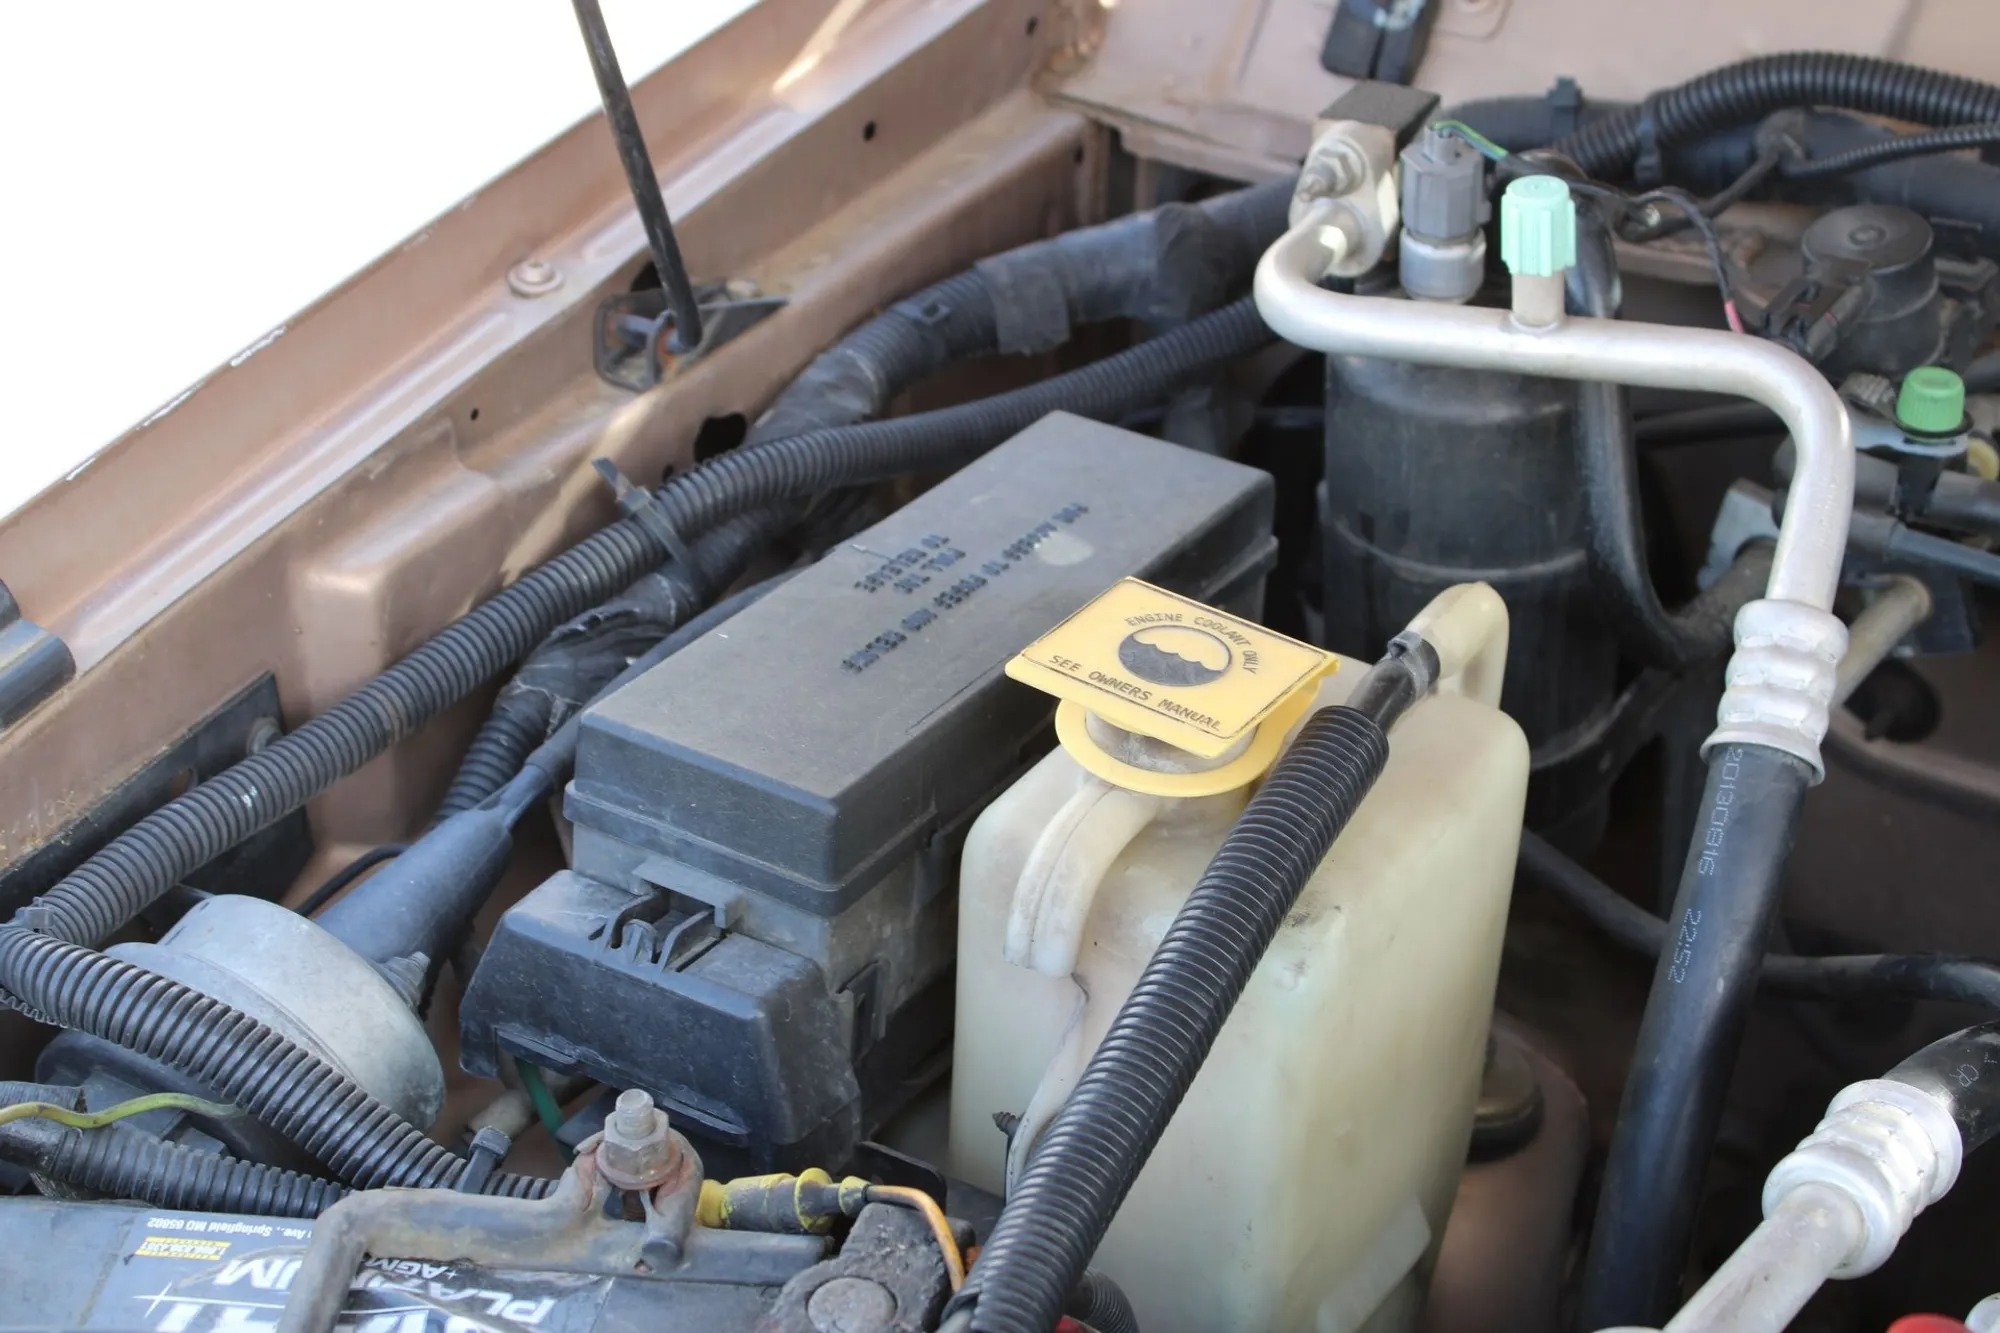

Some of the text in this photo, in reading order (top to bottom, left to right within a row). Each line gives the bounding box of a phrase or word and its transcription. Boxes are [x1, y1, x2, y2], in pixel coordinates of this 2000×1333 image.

[1125, 612, 1257, 674] ENGINE COOLANT ONLY
[1048, 654, 1222, 731] SEE OWNERS MANUAL
[186, 1220, 206, 1232] MO
[207, 1220, 273, 1237] Springfield
